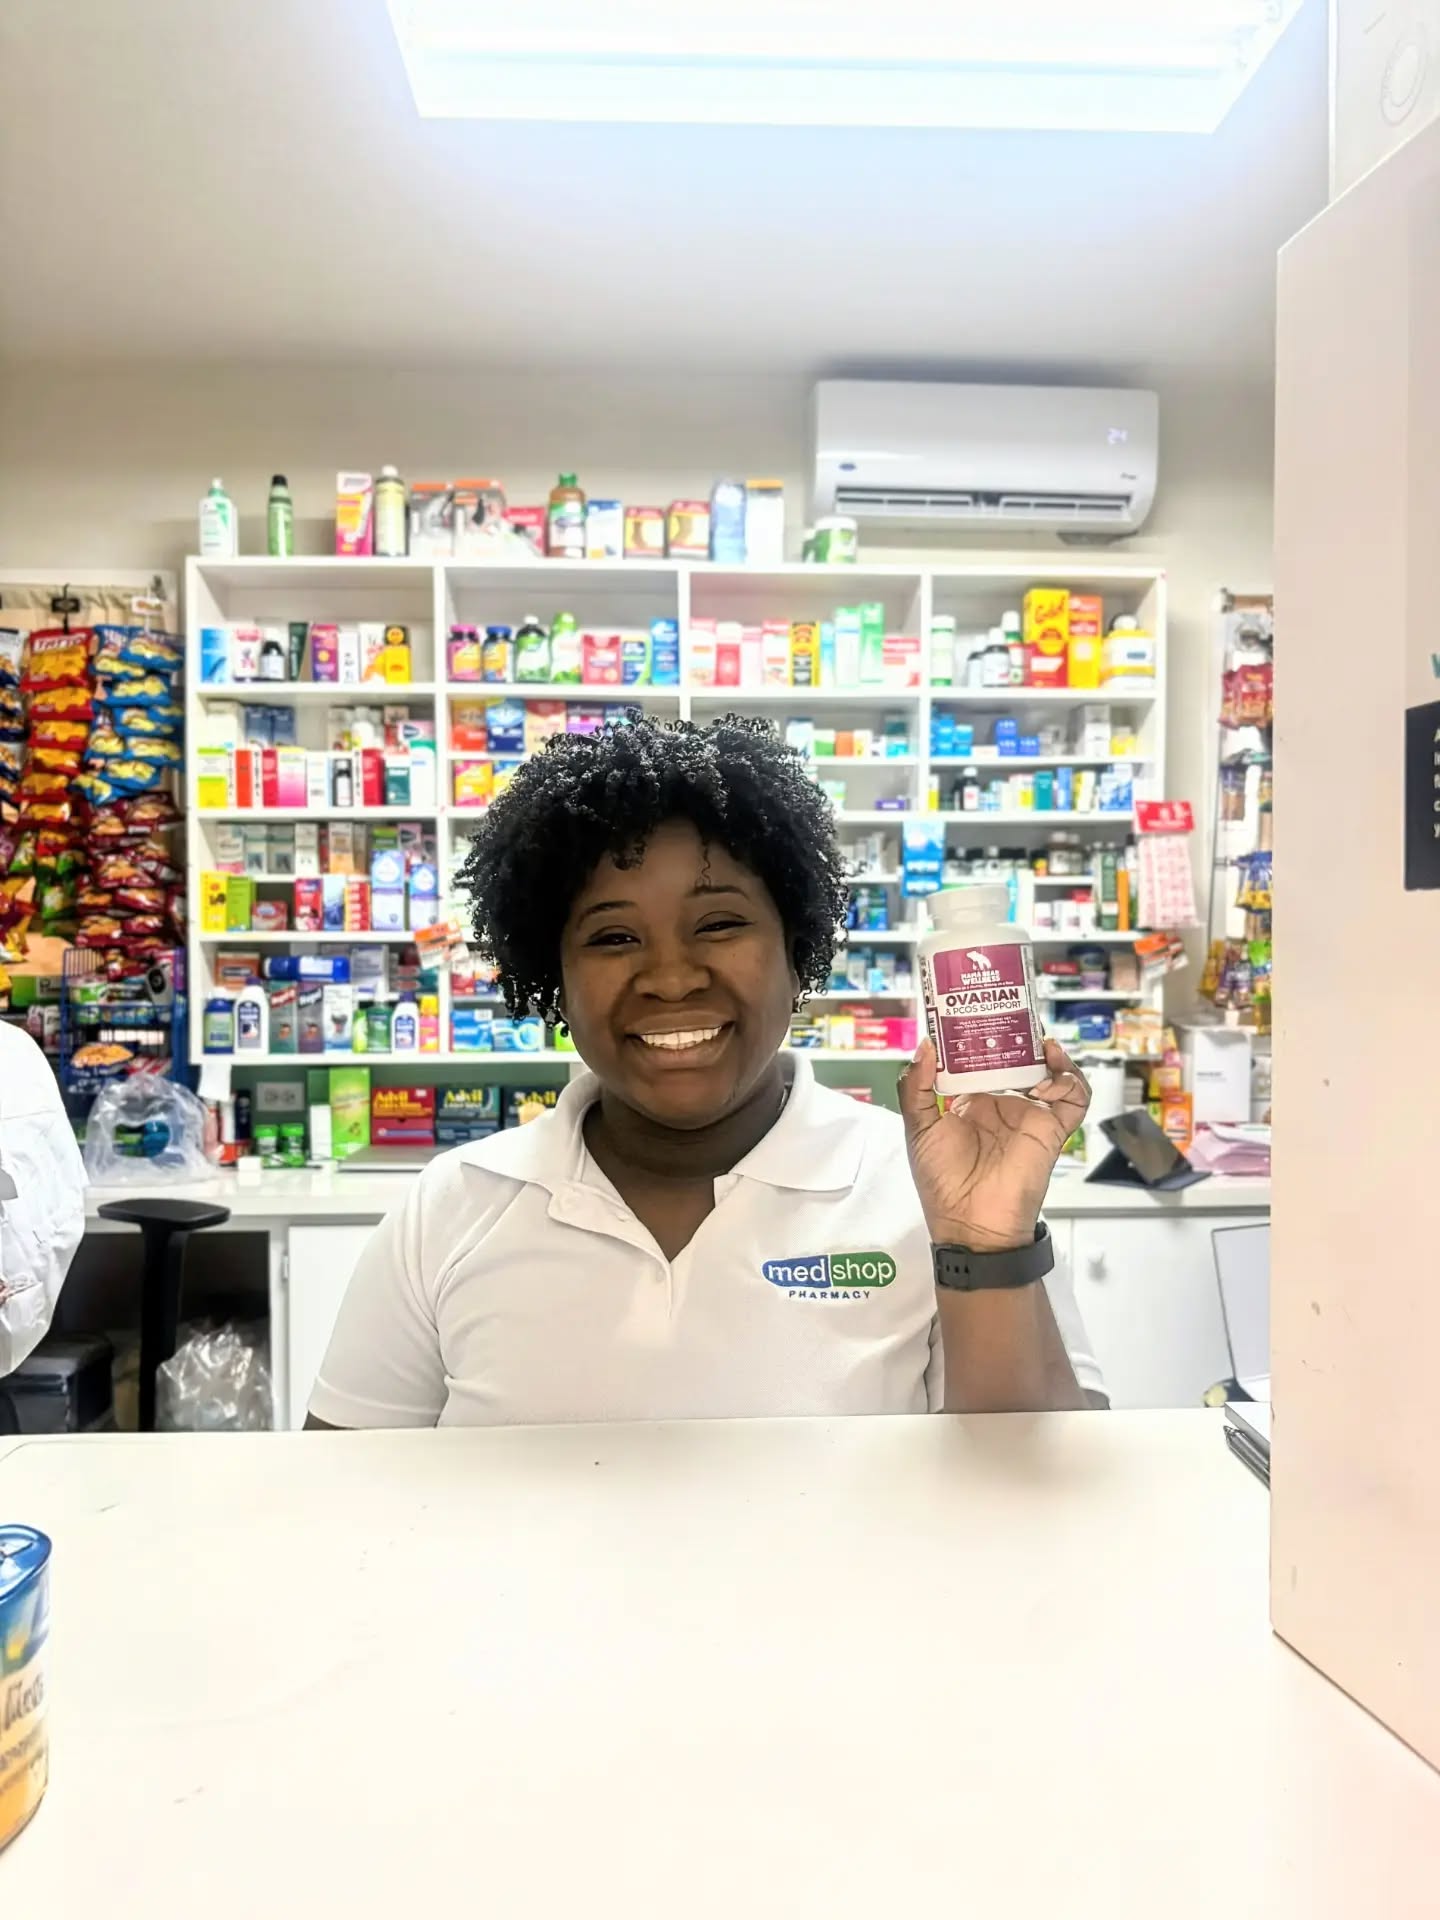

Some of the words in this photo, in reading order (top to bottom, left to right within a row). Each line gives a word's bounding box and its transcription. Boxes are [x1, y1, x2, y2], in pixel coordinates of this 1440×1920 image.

[962, 976, 1001, 986] WELLNESS
[945, 988, 1019, 1008] OVARIAN
[945, 1008, 952, 1016] &
[953, 1005, 978, 1015] PCOS
[980, 1001, 1021, 1012] SUPPORT
[444, 1088, 483, 1103] Advil
[788, 1290, 871, 1300] PHARMACY
